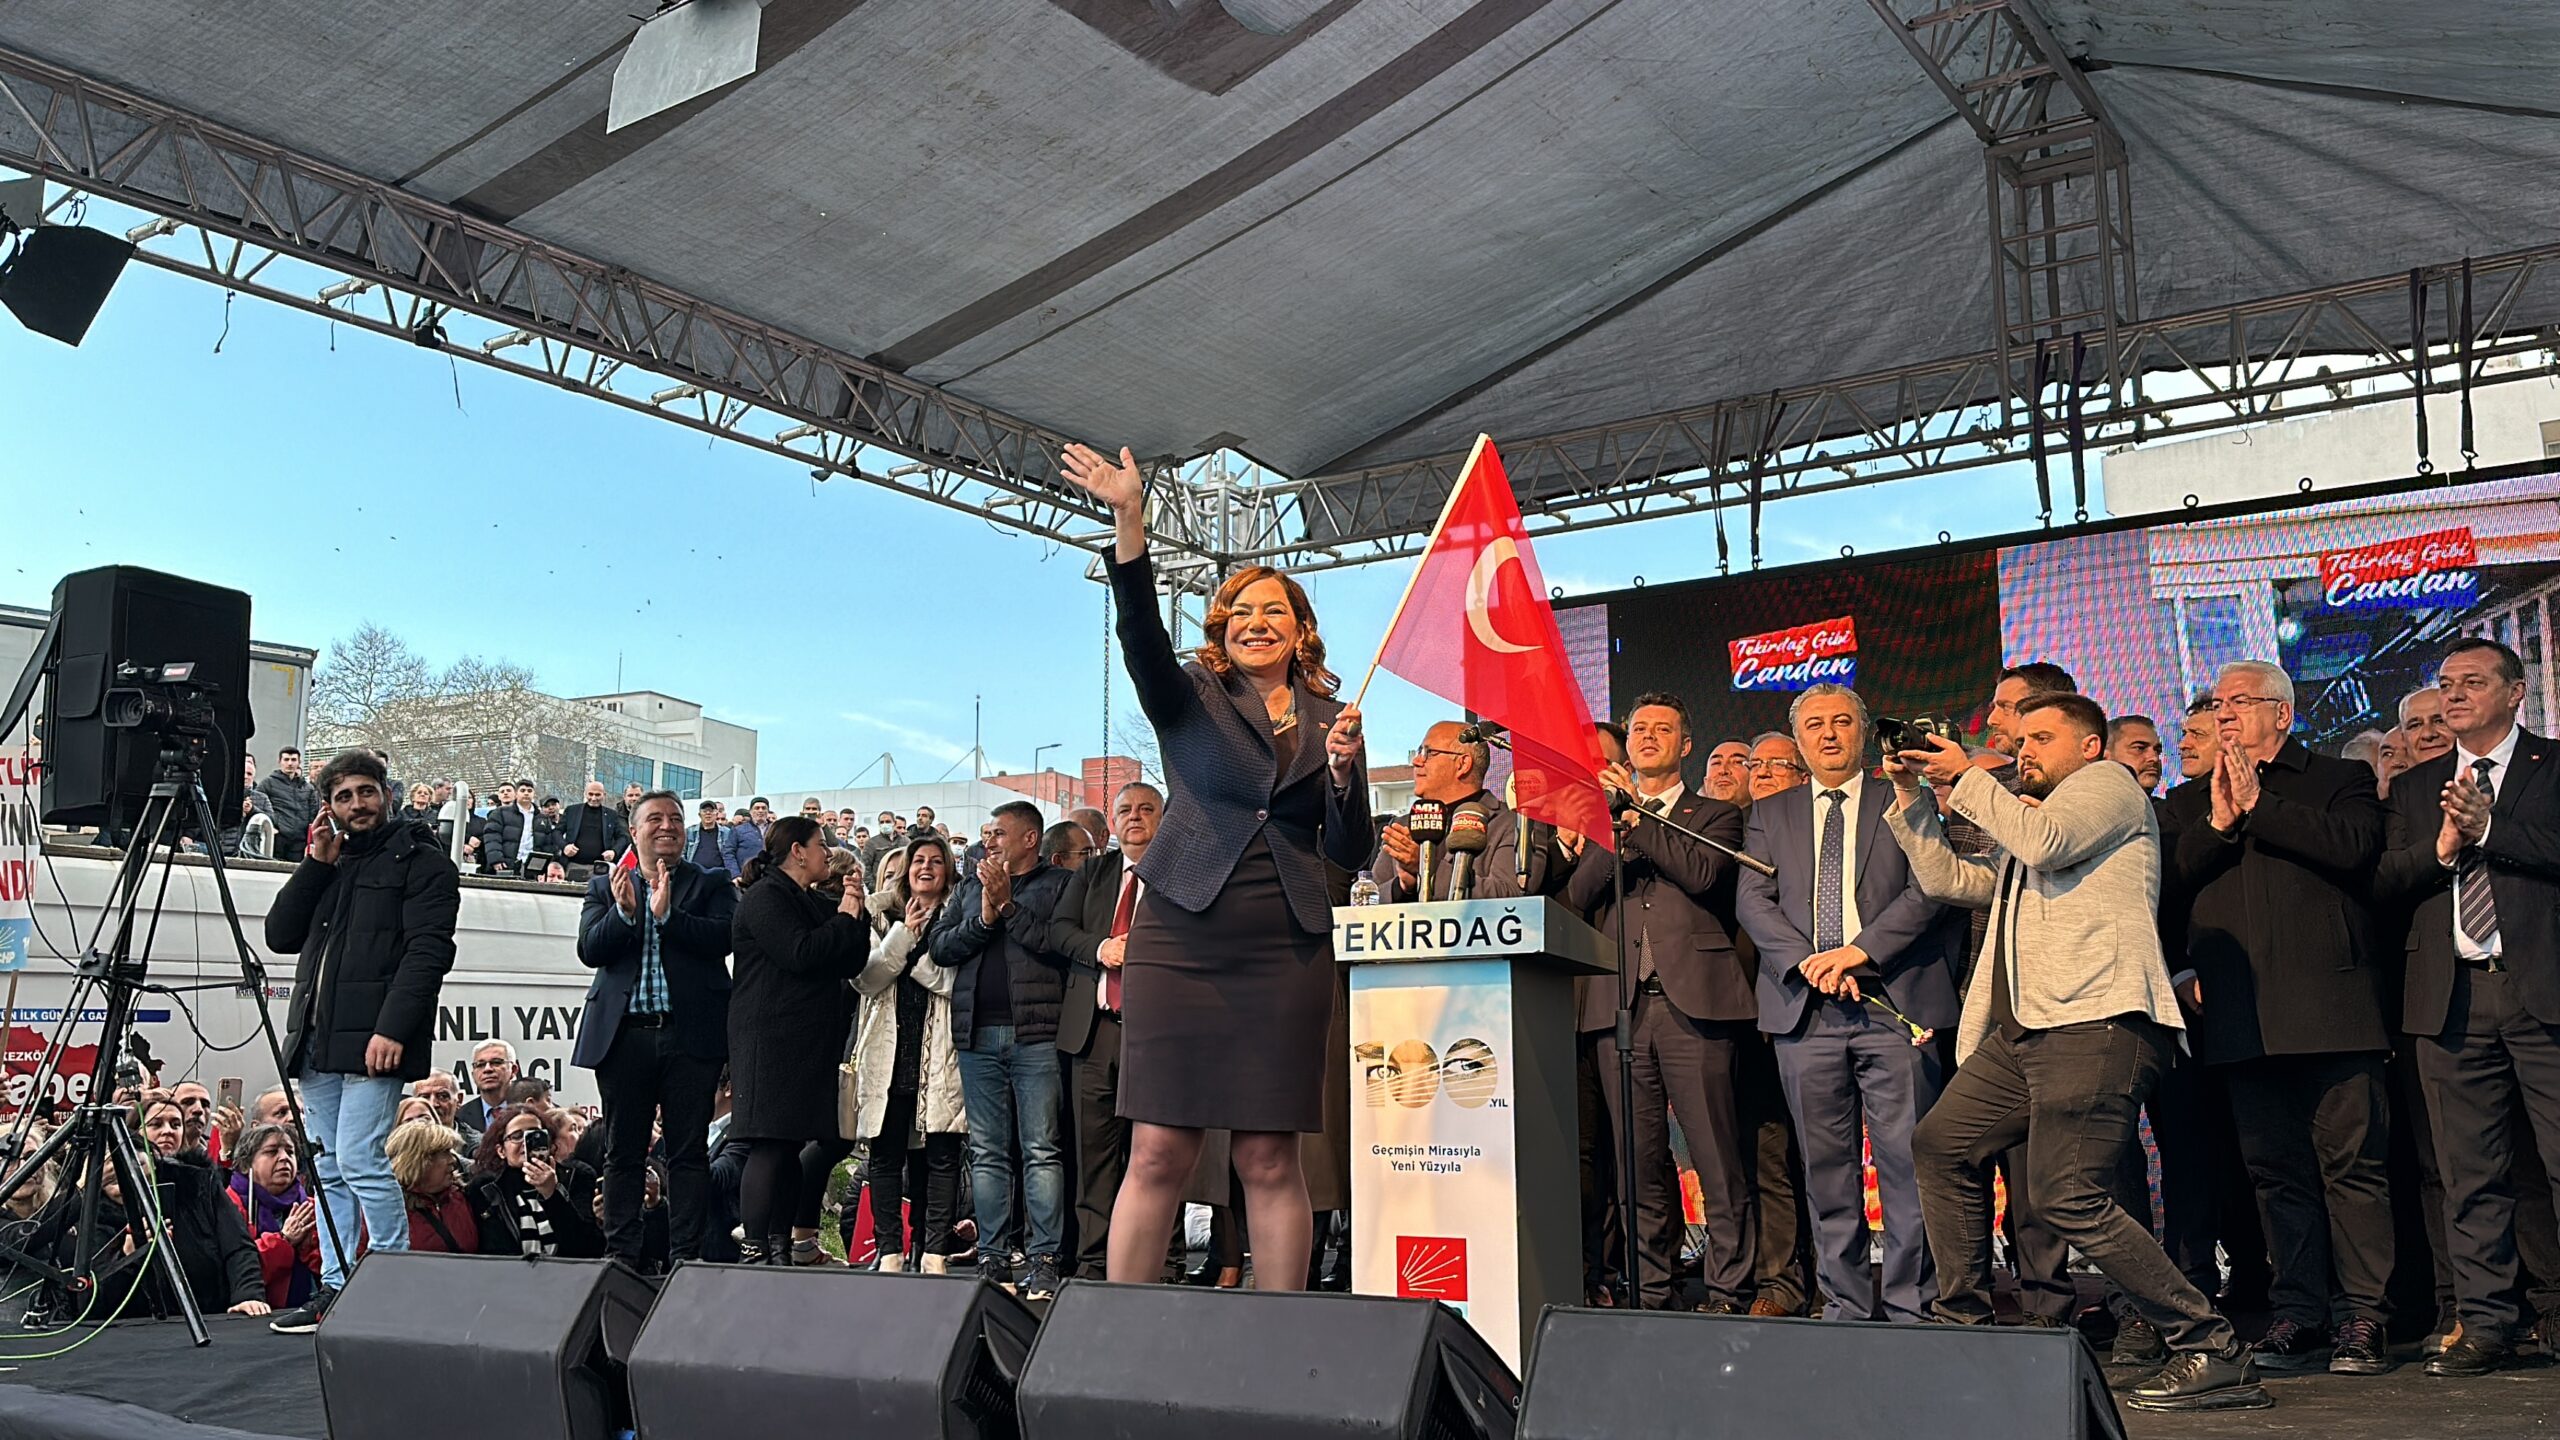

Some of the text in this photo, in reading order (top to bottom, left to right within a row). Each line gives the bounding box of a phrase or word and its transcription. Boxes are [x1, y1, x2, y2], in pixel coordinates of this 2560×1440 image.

[2327, 542, 2469, 574] Tekirdağ Gibi
[2326, 567, 2477, 606] Candan
[1737, 630, 1850, 657] Tekirdağ Gibi
[1733, 653, 1855, 689] Candan
[1411, 820, 1443, 831] HABER
[1333, 906, 1522, 952] EKİRDAĞ
[20, 1009, 38, 1021] İLK
[431, 1006, 500, 1041] NLI
[1372, 1144, 1481, 1158] Geçmişin Mirasıyla
[1391, 1161, 1462, 1174] Yeni Yüzyıla
